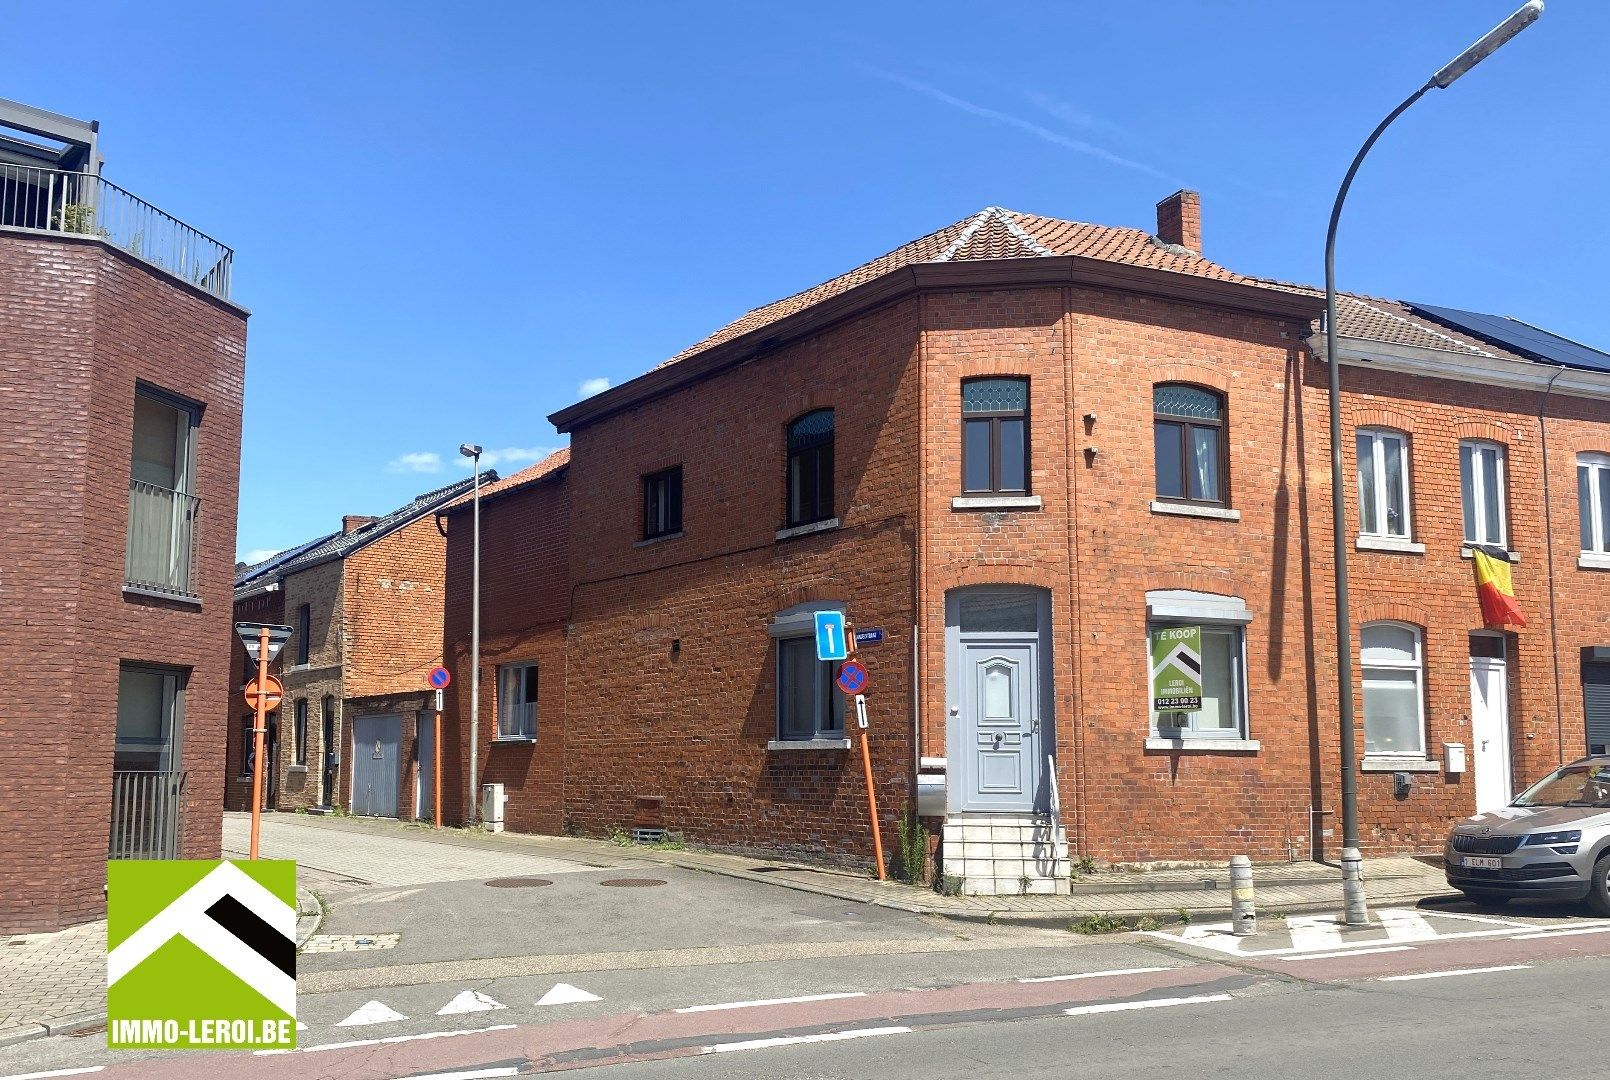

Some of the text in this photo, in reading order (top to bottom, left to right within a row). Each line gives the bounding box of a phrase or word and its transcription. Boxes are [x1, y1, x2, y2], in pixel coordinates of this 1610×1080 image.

[1154, 629, 1197, 641] TE KOOP
[1170, 697, 1179, 705] 23
[1189, 696, 1198, 704] 23
[1471, 858, 1484, 867] ELM
[1487, 859, 1500, 868] 601
